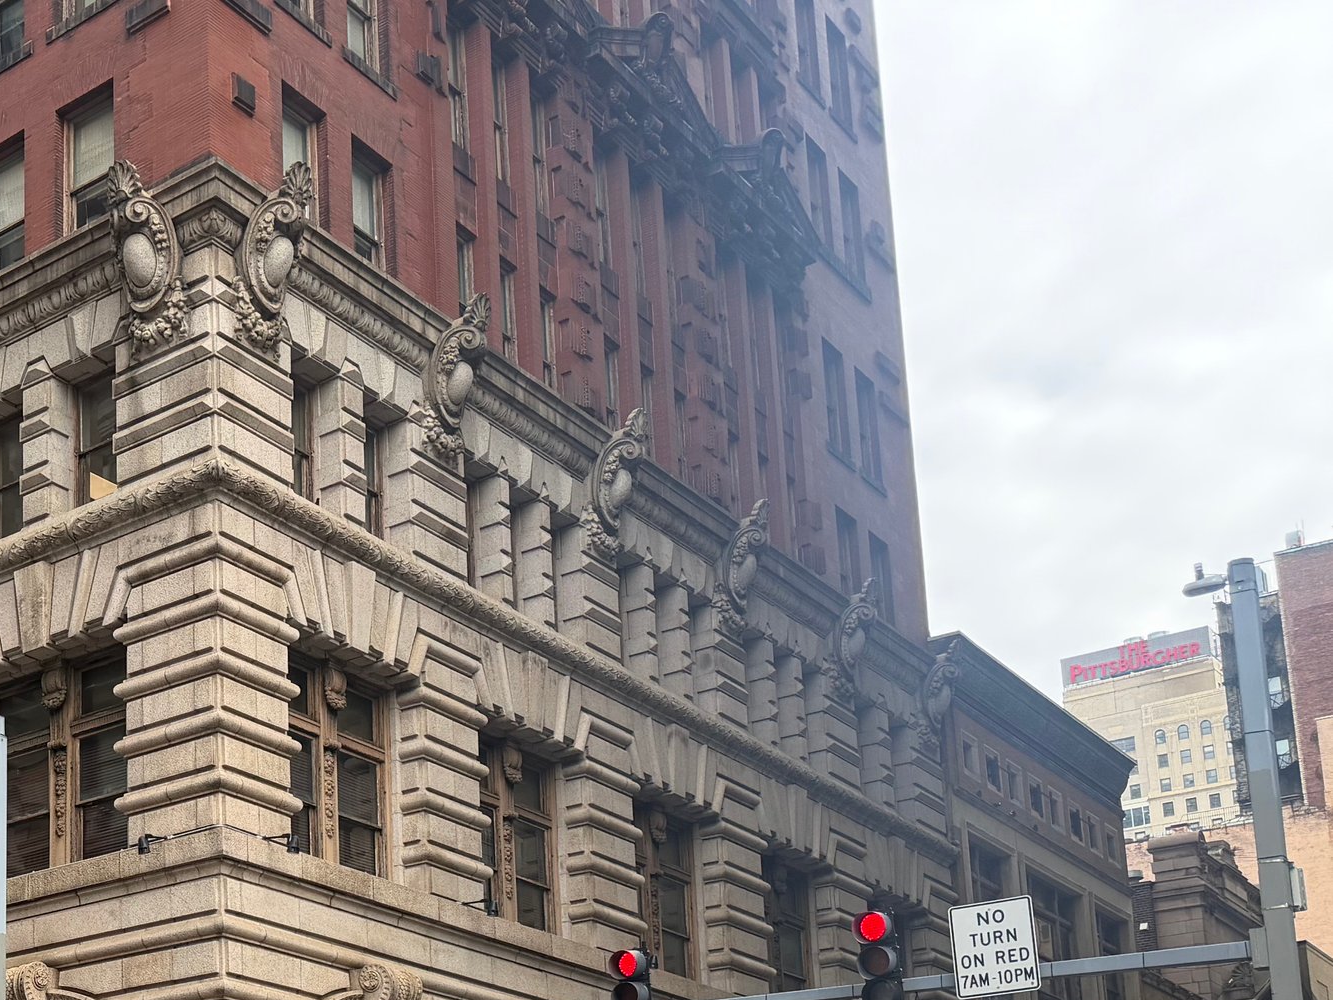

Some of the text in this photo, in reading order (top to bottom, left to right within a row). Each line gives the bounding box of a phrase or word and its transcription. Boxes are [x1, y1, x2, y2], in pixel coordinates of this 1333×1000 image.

[1118, 640, 1148, 660] THE
[1069, 642, 1202, 684] PITTSBURGHER
[976, 909, 1005, 926] NO
[969, 928, 1018, 947] TURN
[961, 947, 1030, 969] ON RED
[960, 966, 1035, 989] 7AM-10PM
